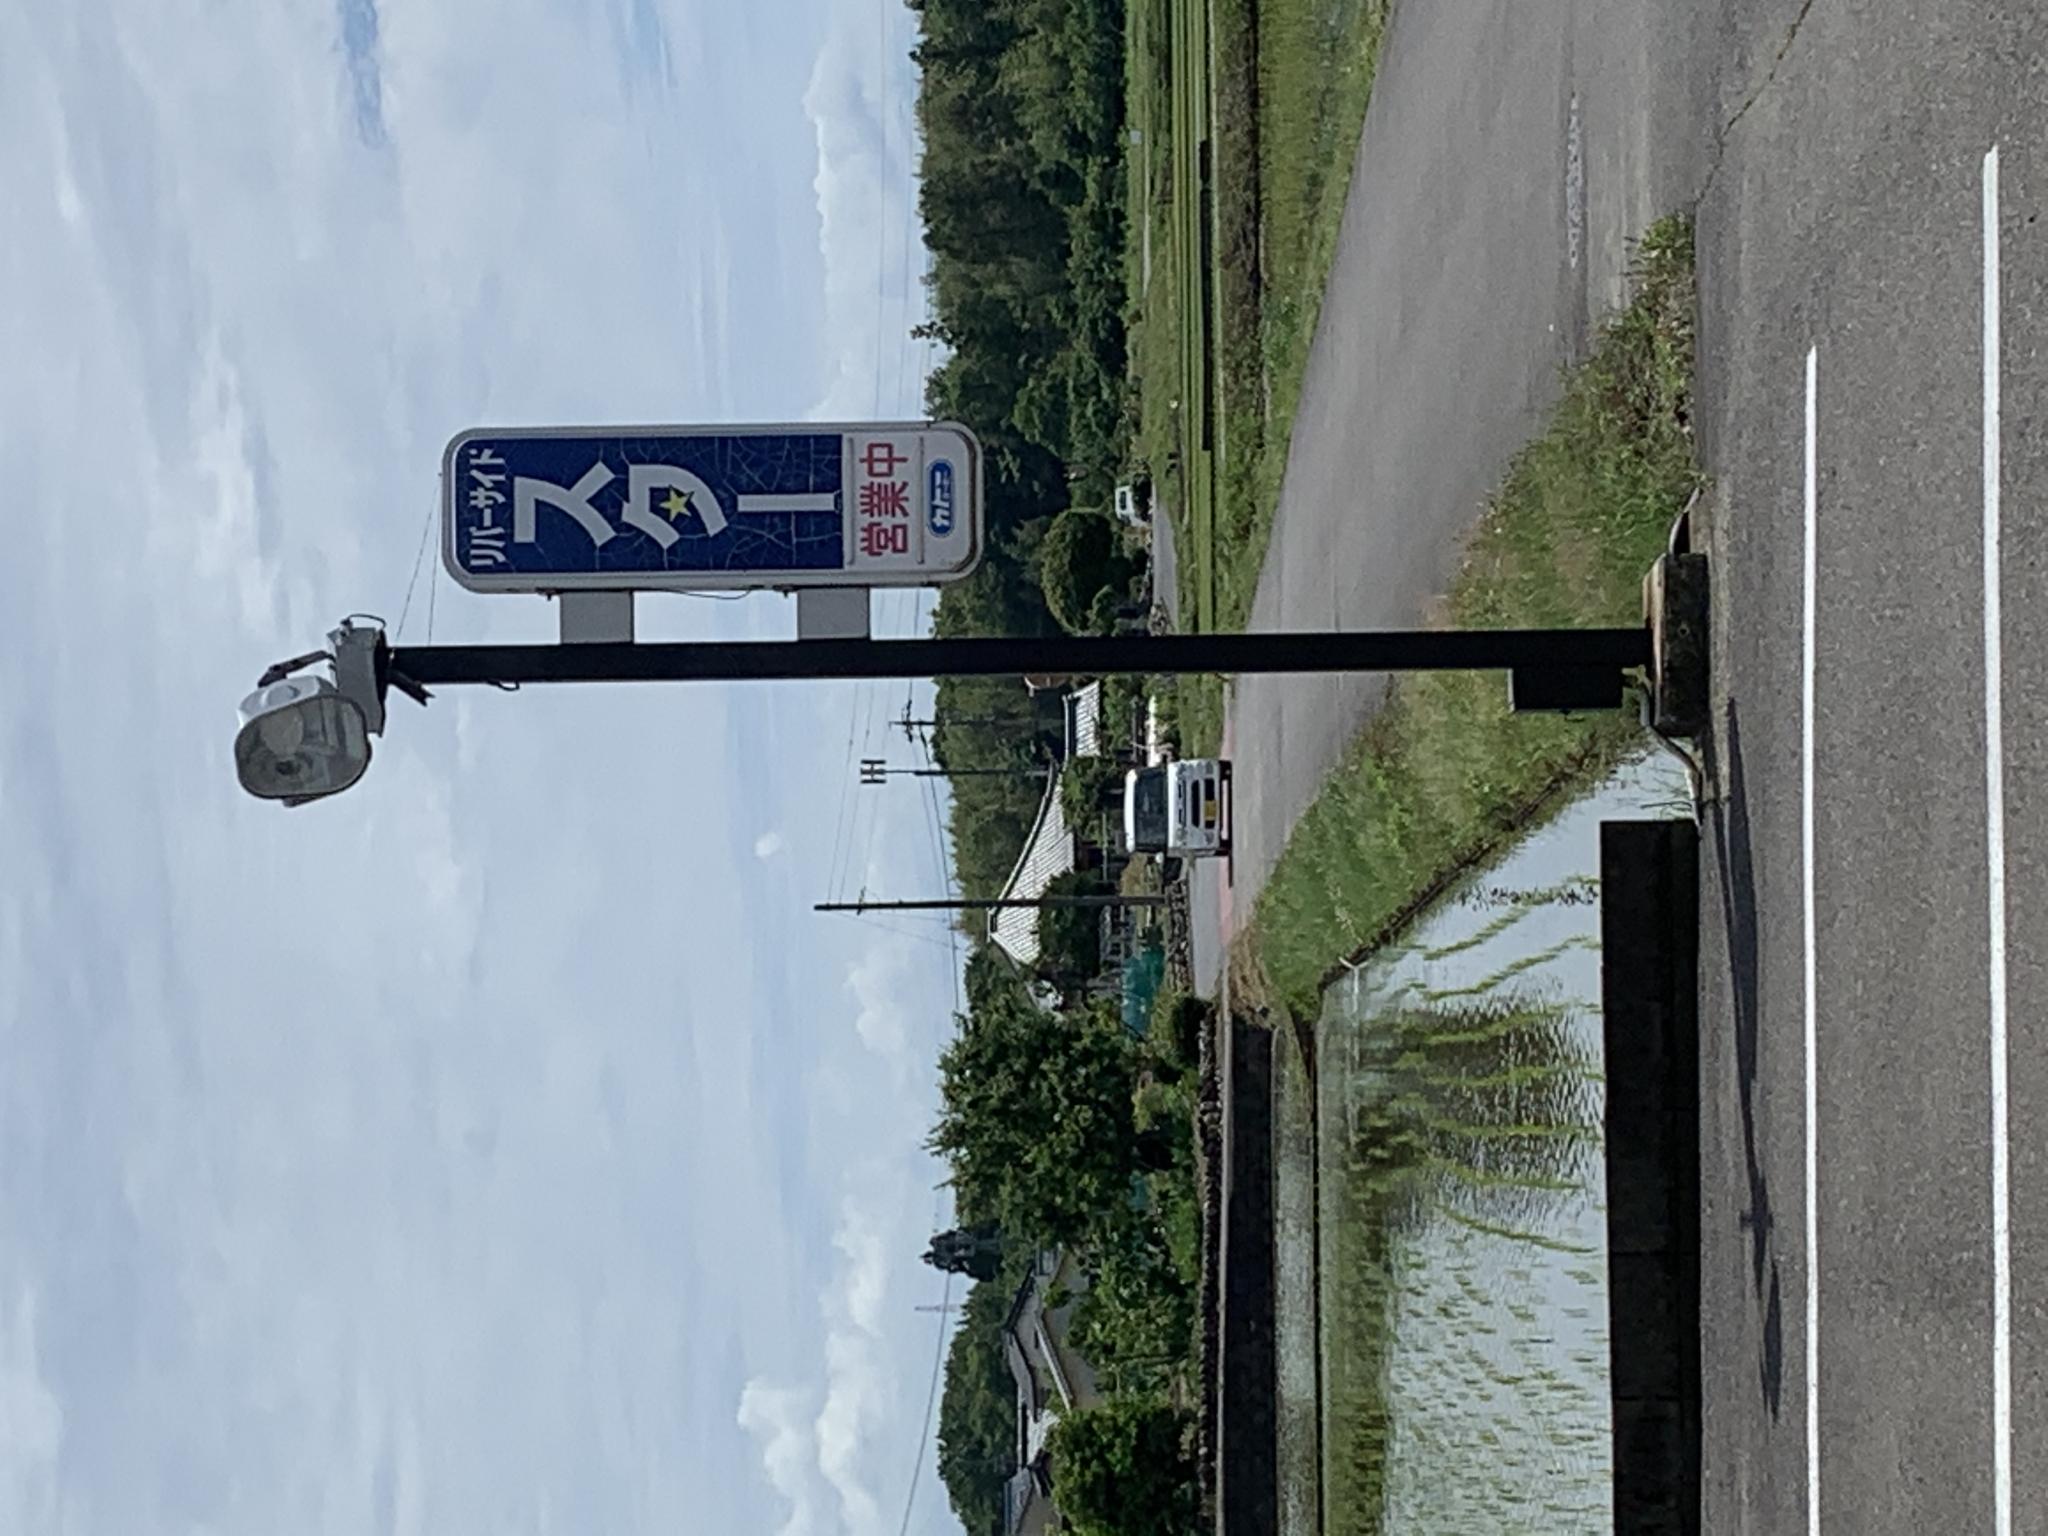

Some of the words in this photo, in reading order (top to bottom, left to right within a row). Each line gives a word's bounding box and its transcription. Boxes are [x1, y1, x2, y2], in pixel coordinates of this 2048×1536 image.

[469, 448, 506, 566] リバーサイド
[513, 460, 835, 549] スター
[859, 442, 908, 556] 営業中
